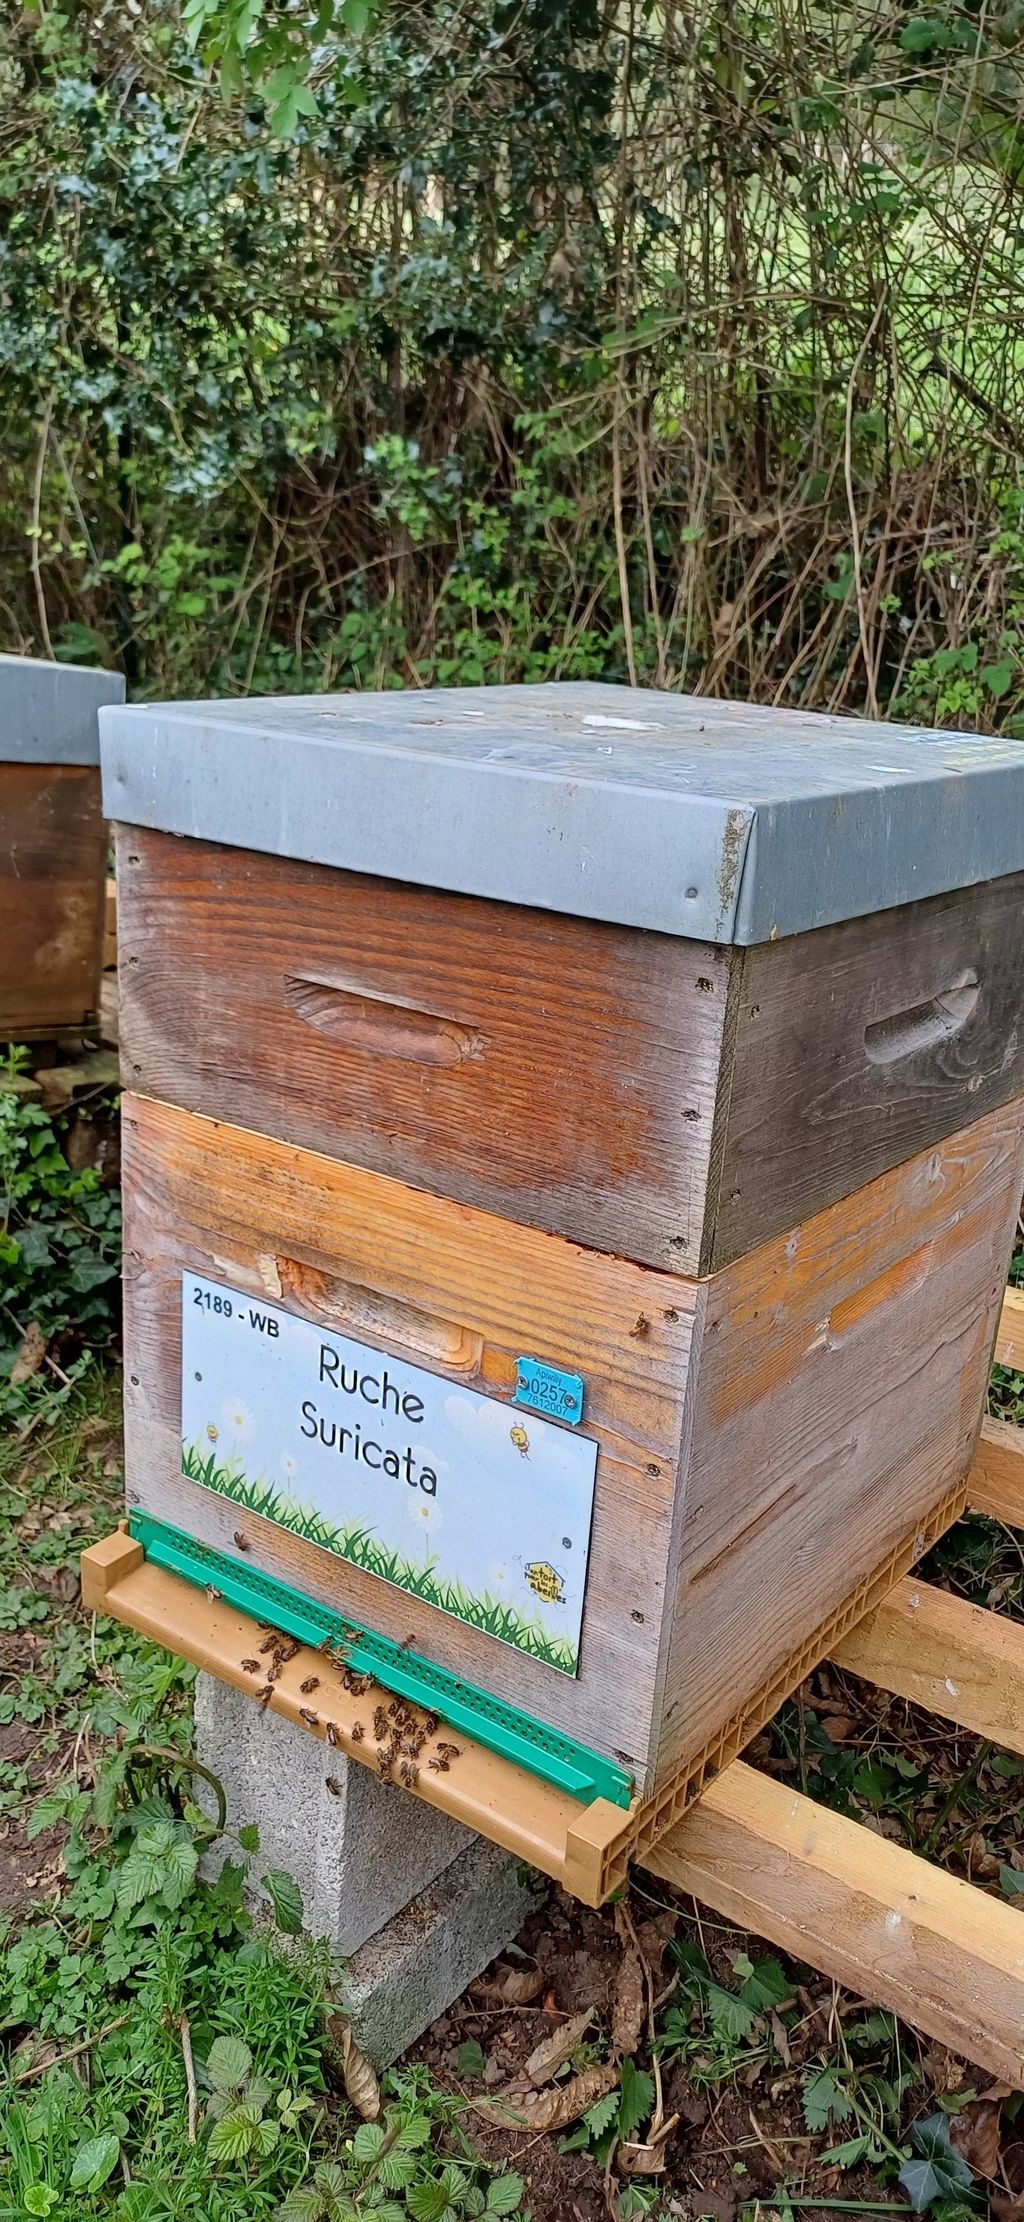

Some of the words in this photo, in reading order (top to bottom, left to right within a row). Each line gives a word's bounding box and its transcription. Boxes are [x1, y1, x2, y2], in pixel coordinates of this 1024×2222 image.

[194, 1287, 232, 1317] 2189
[249, 1309, 279, 1338] WB
[319, 1344, 424, 1423] Ruche
[528, 1393, 568, 1415] 7612007
[531, 1378, 567, 1404] 0257
[300, 1401, 437, 1497] Suricata
